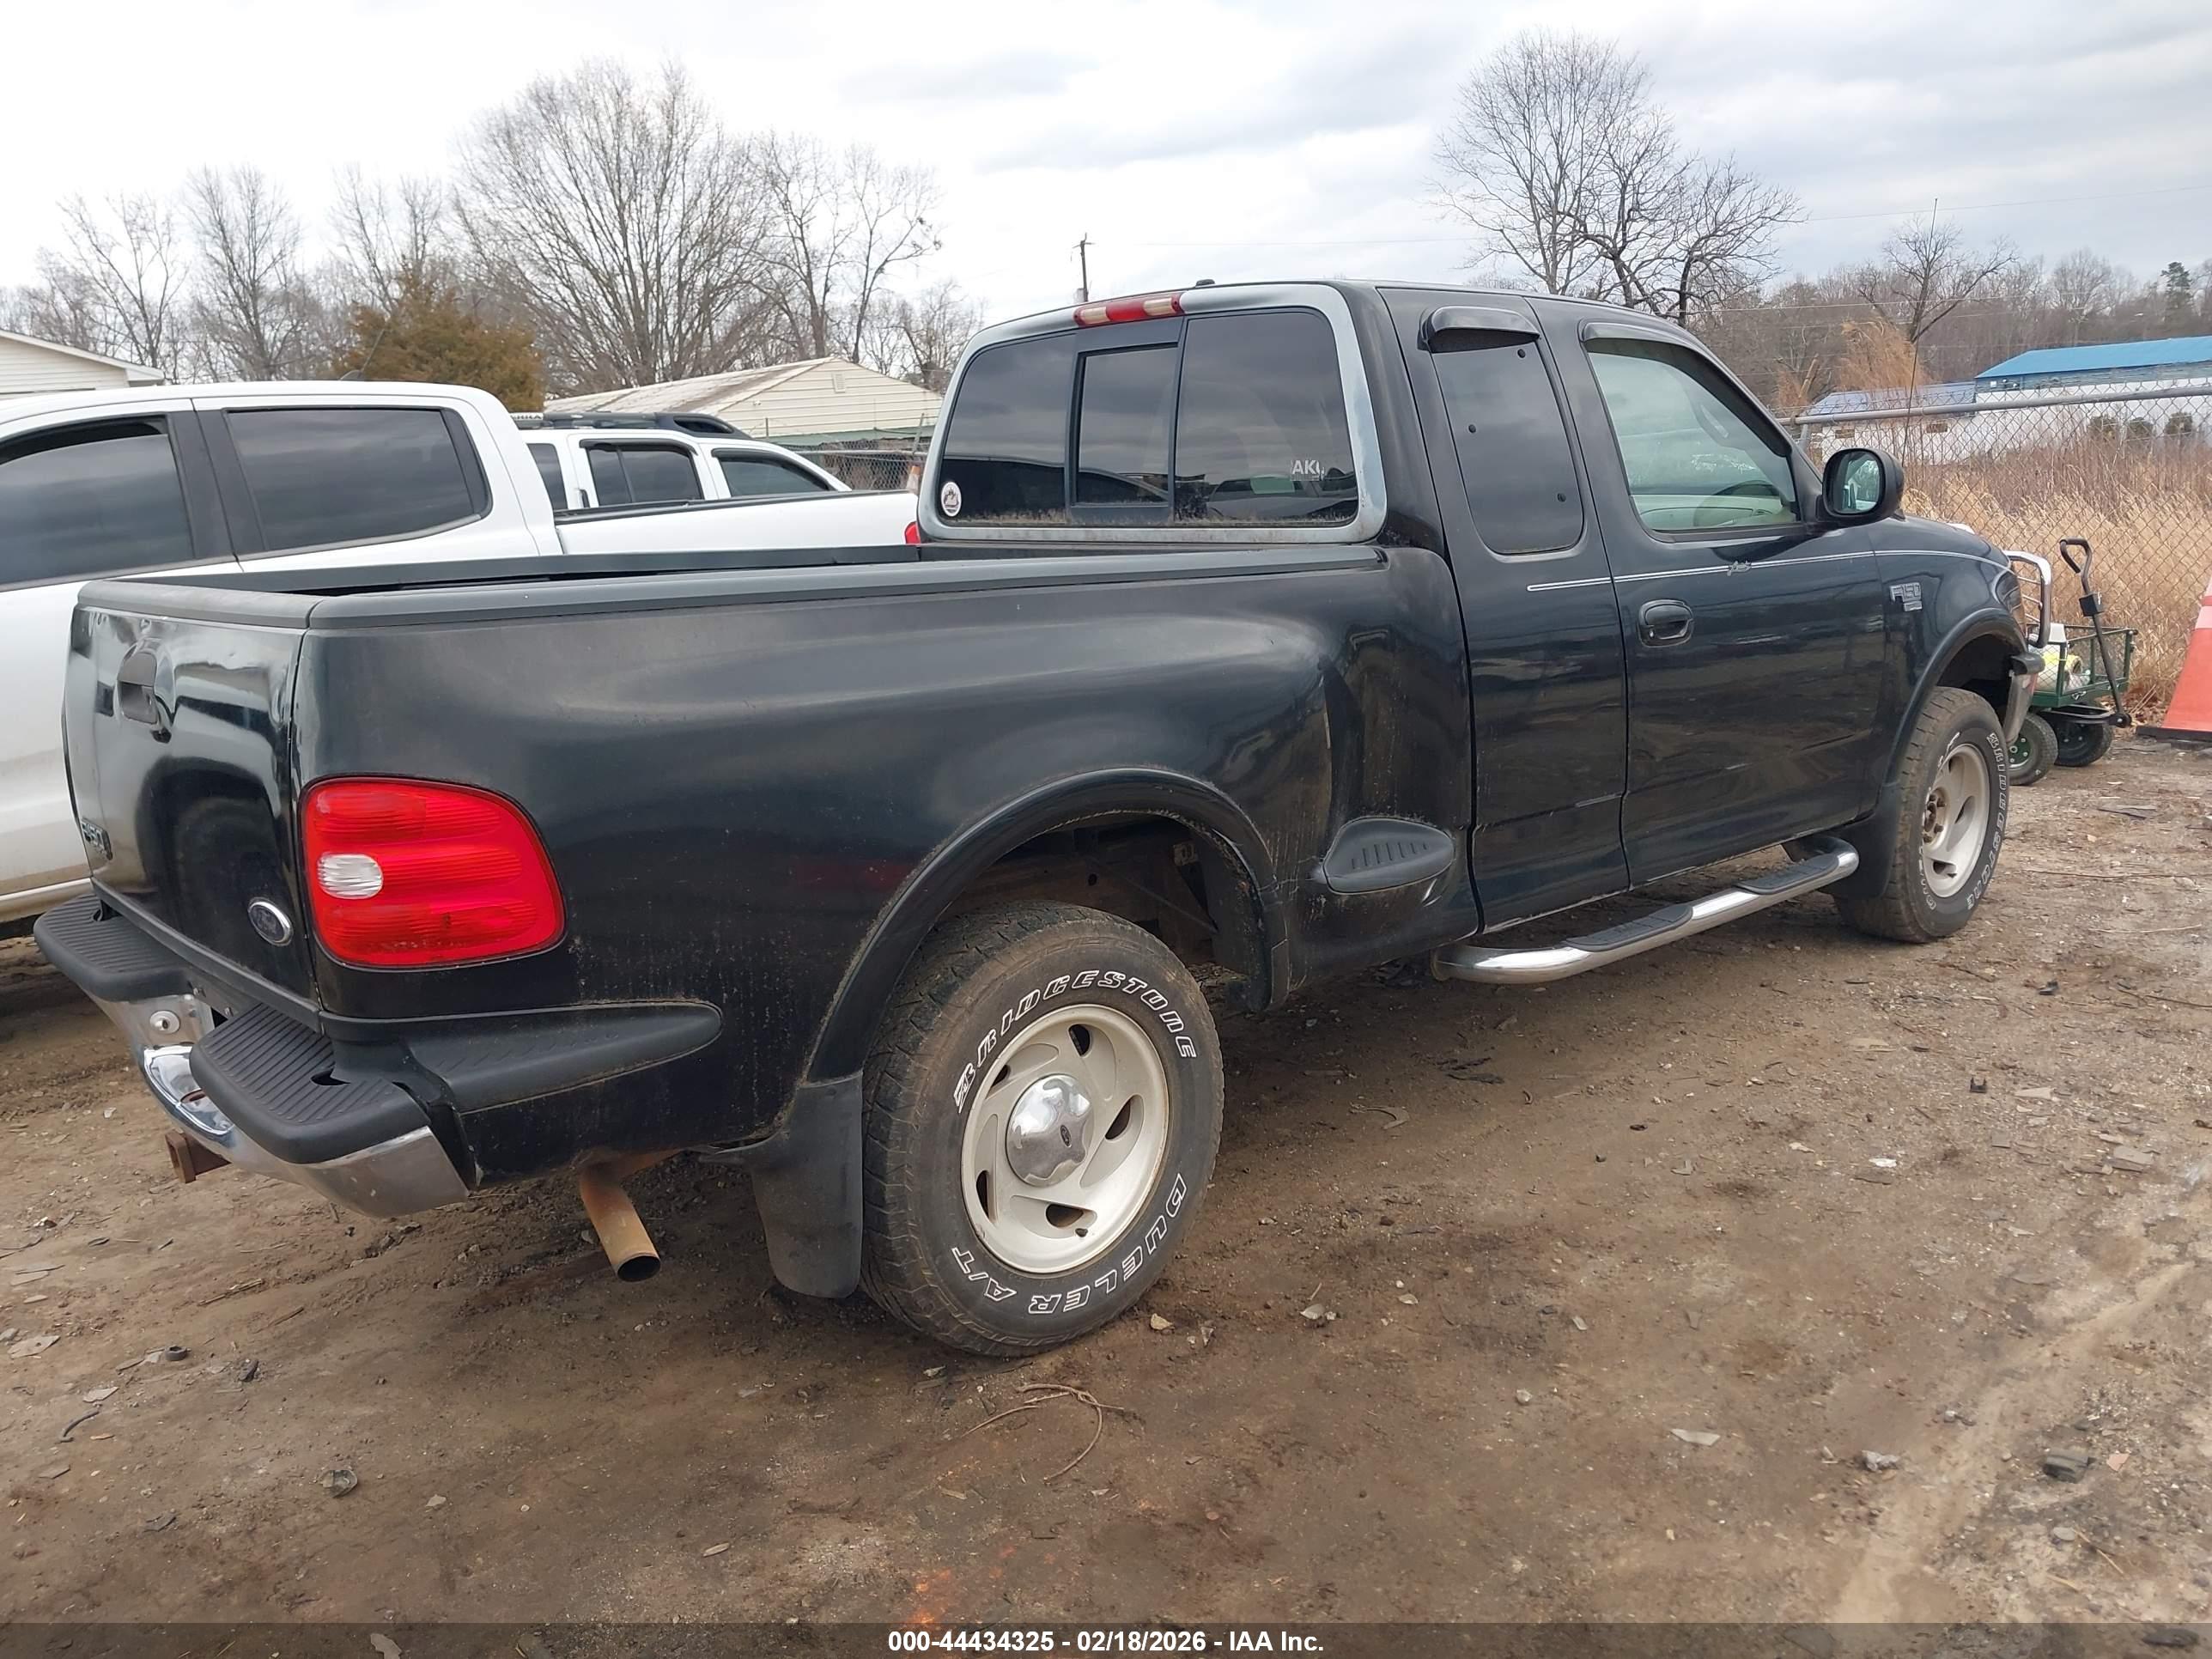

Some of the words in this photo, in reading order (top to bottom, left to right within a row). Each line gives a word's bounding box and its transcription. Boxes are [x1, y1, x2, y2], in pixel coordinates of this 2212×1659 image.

[953, 969, 1198, 1115] BRIDGESTONE
[951, 1246, 1018, 1302] A/T
[1028, 1173, 1188, 1315] DUELER
